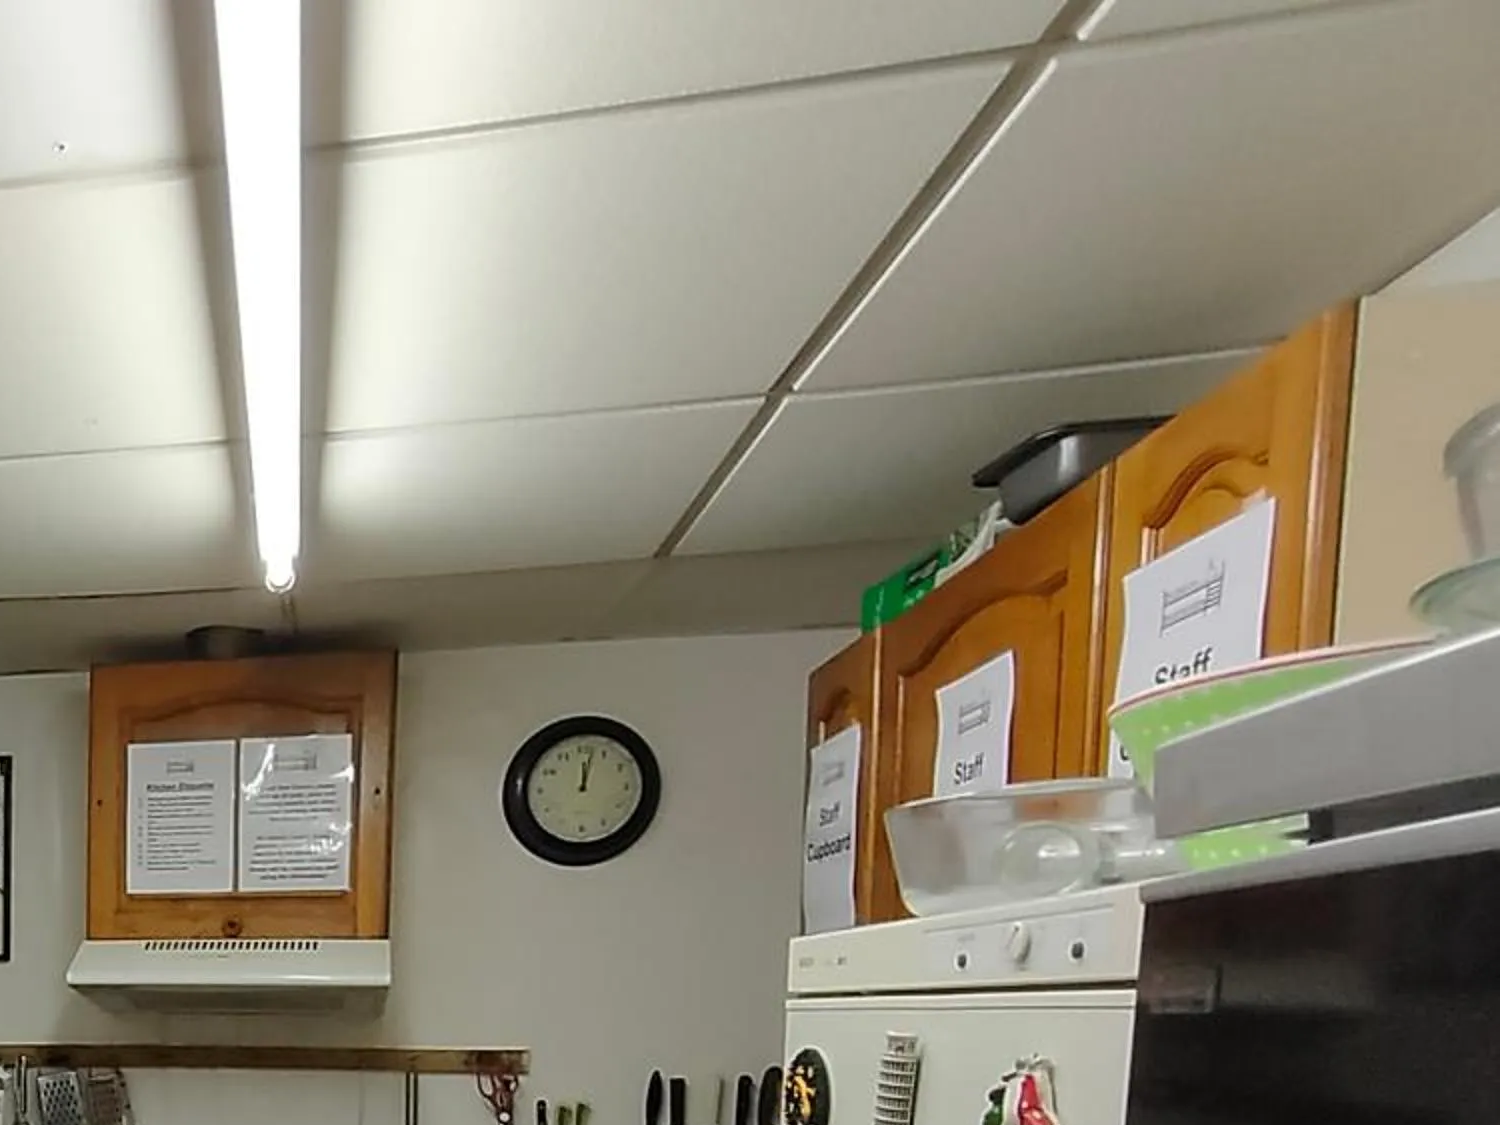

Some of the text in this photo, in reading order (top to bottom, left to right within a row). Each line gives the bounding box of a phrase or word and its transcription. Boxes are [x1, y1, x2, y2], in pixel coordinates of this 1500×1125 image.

[954, 751, 985, 785] Staff
[819, 800, 840, 827] Staff
[807, 832, 851, 862] Cupboard
